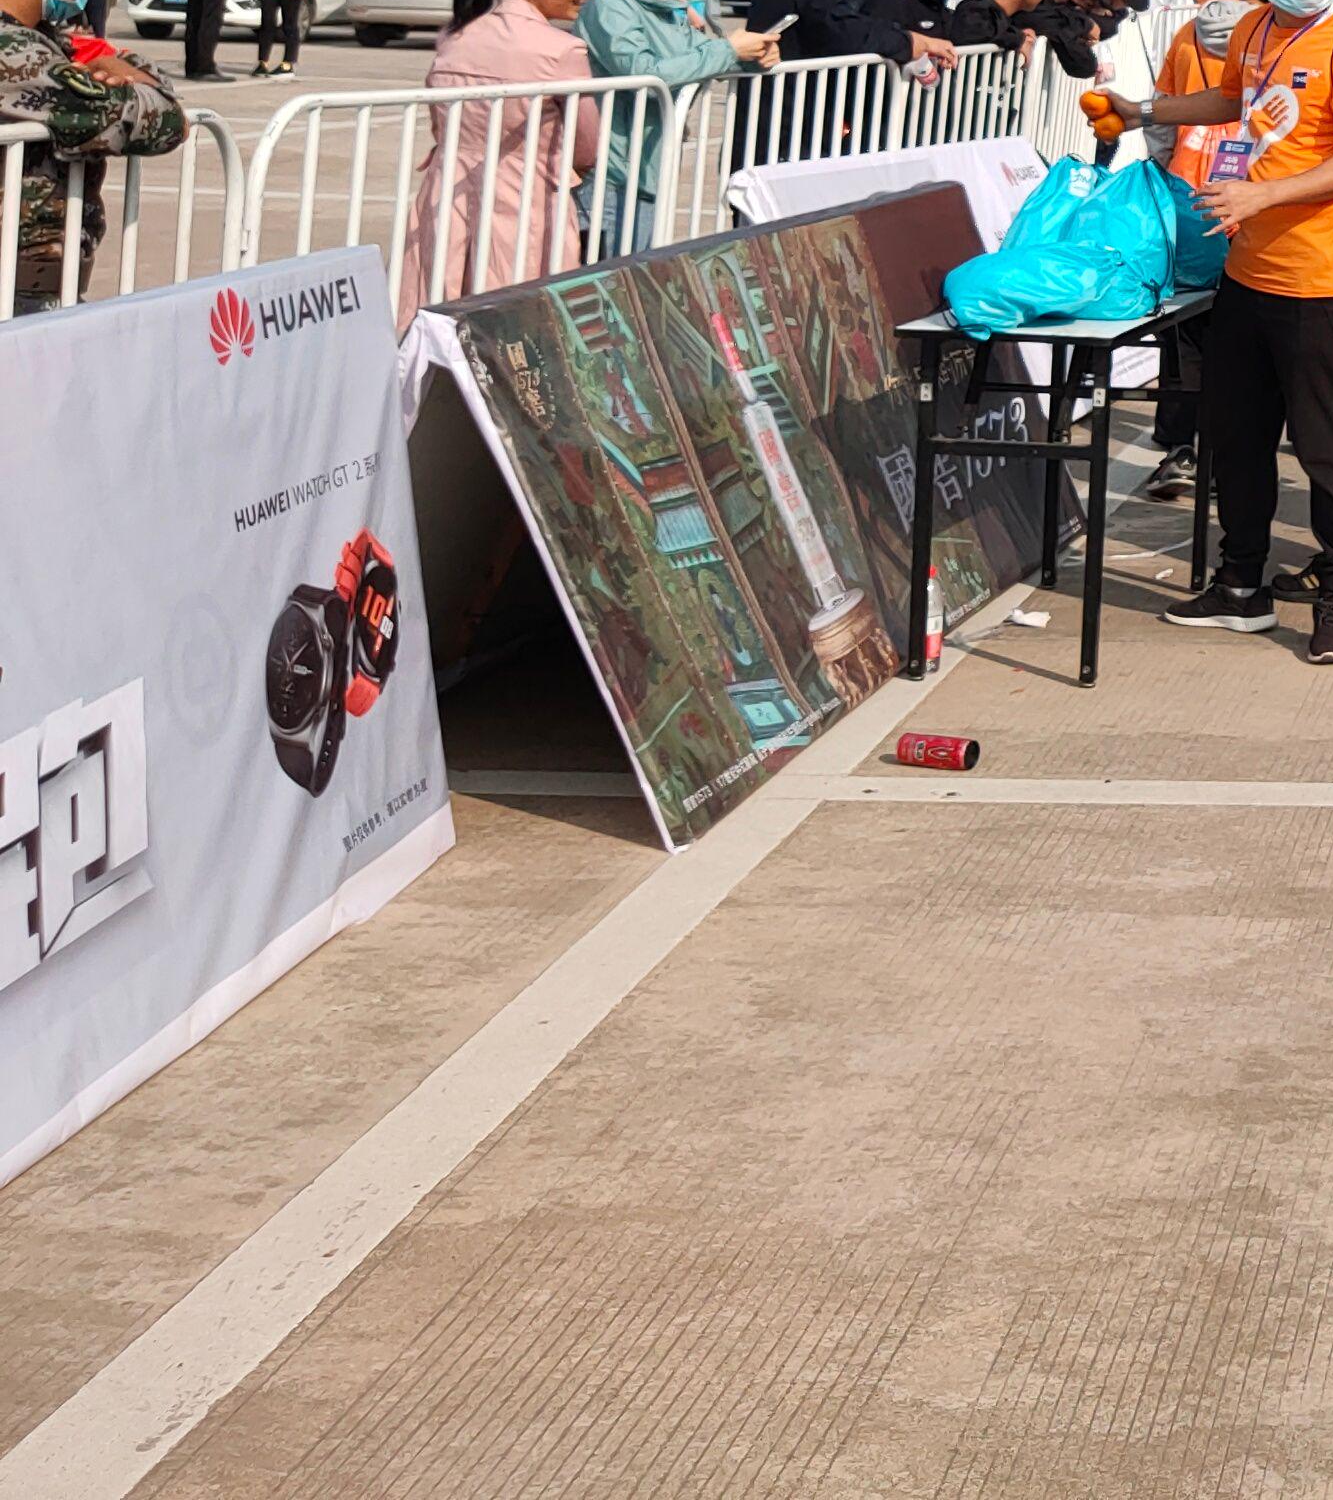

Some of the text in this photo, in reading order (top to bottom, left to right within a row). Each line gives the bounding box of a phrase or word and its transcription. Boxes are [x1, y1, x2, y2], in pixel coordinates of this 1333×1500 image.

[260, 275, 361, 340] HUAWEI
[234, 489, 291, 533] HUAWEI
[292, 473, 332, 506] WATCH
[333, 463, 349, 489] GT
[351, 460, 364, 481] 2
